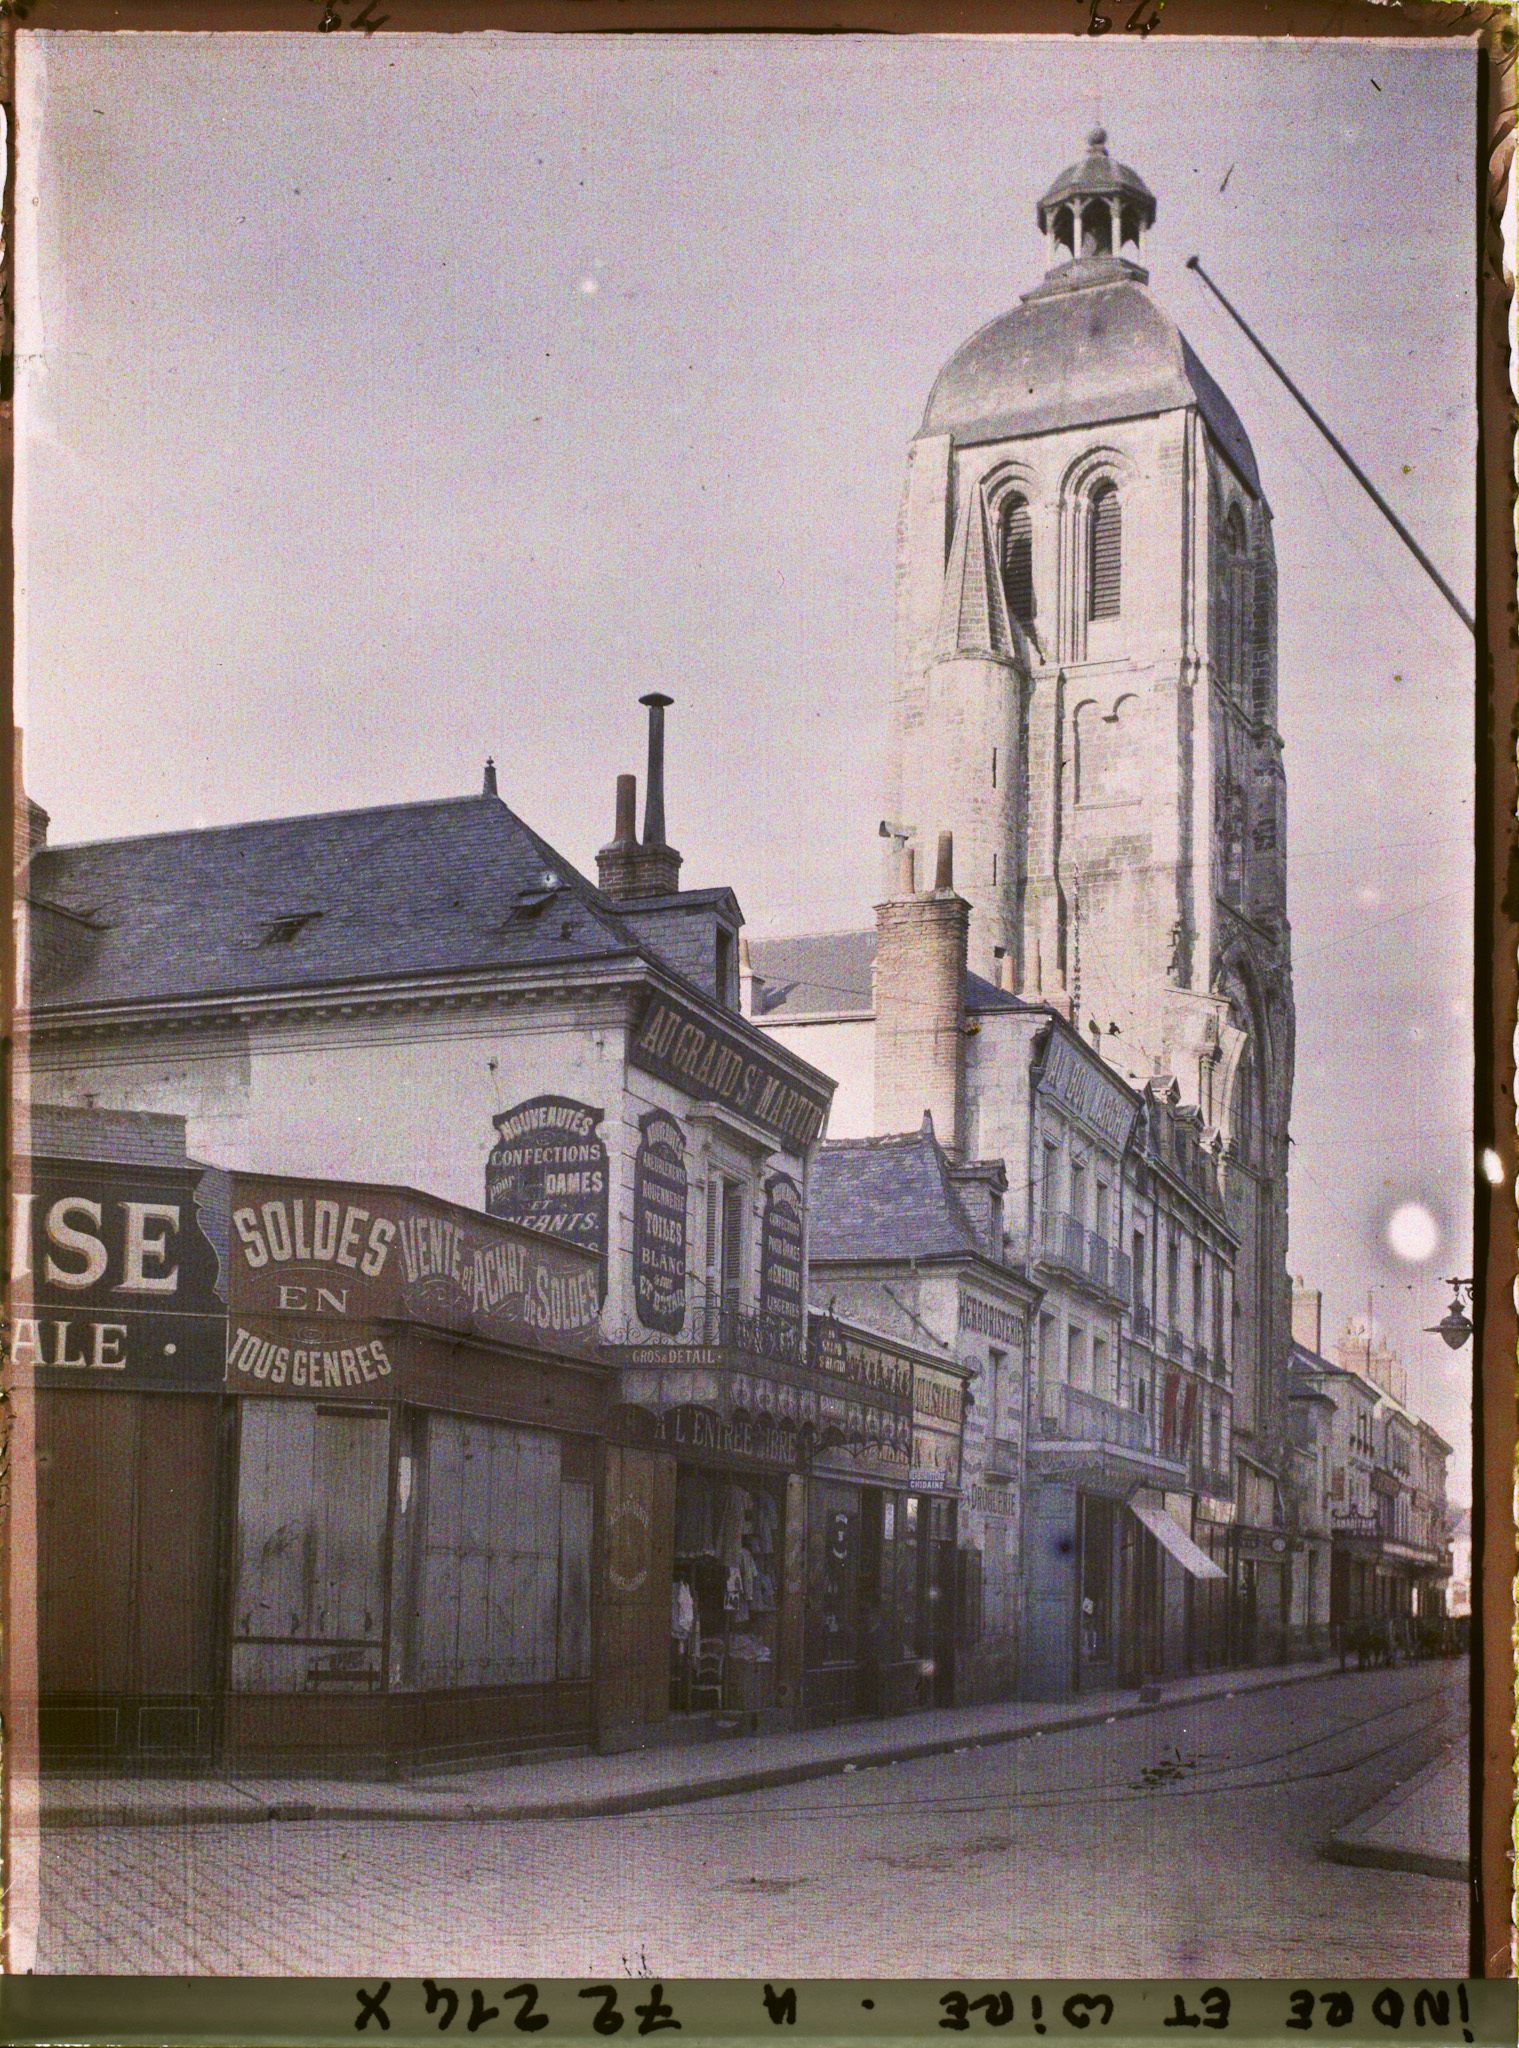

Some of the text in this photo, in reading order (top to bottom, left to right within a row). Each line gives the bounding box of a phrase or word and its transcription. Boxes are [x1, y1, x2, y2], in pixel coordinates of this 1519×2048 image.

[641, 1005, 681, 1057] AU
[672, 1022, 743, 1098] GRAND
[754, 1076, 824, 1146] MARTIN
[491, 1144, 602, 1167] CONFECTIONS
[530, 1199, 554, 1211] ET
[545, 1171, 604, 1196] DAMES
[233, 1199, 396, 1278] SOLDES
[644, 1210, 683, 1248] TOILES
[398, 1215, 464, 1283] VENTE
[471, 1242, 528, 1313] ACHAT
[641, 1246, 685, 1278] BLANC
[276, 1284, 349, 1314] EN
[11, 1318, 128, 1371] ALE
[227, 1327, 393, 1388] TOUS GENRES
[631, 1348, 661, 1363] GROS
[667, 1347, 715, 1363] DETAIL
[354, 1981, 391, 2031] X
[578, 1983, 682, 2036] 72
[1164, 1986, 1231, 2030] ET
